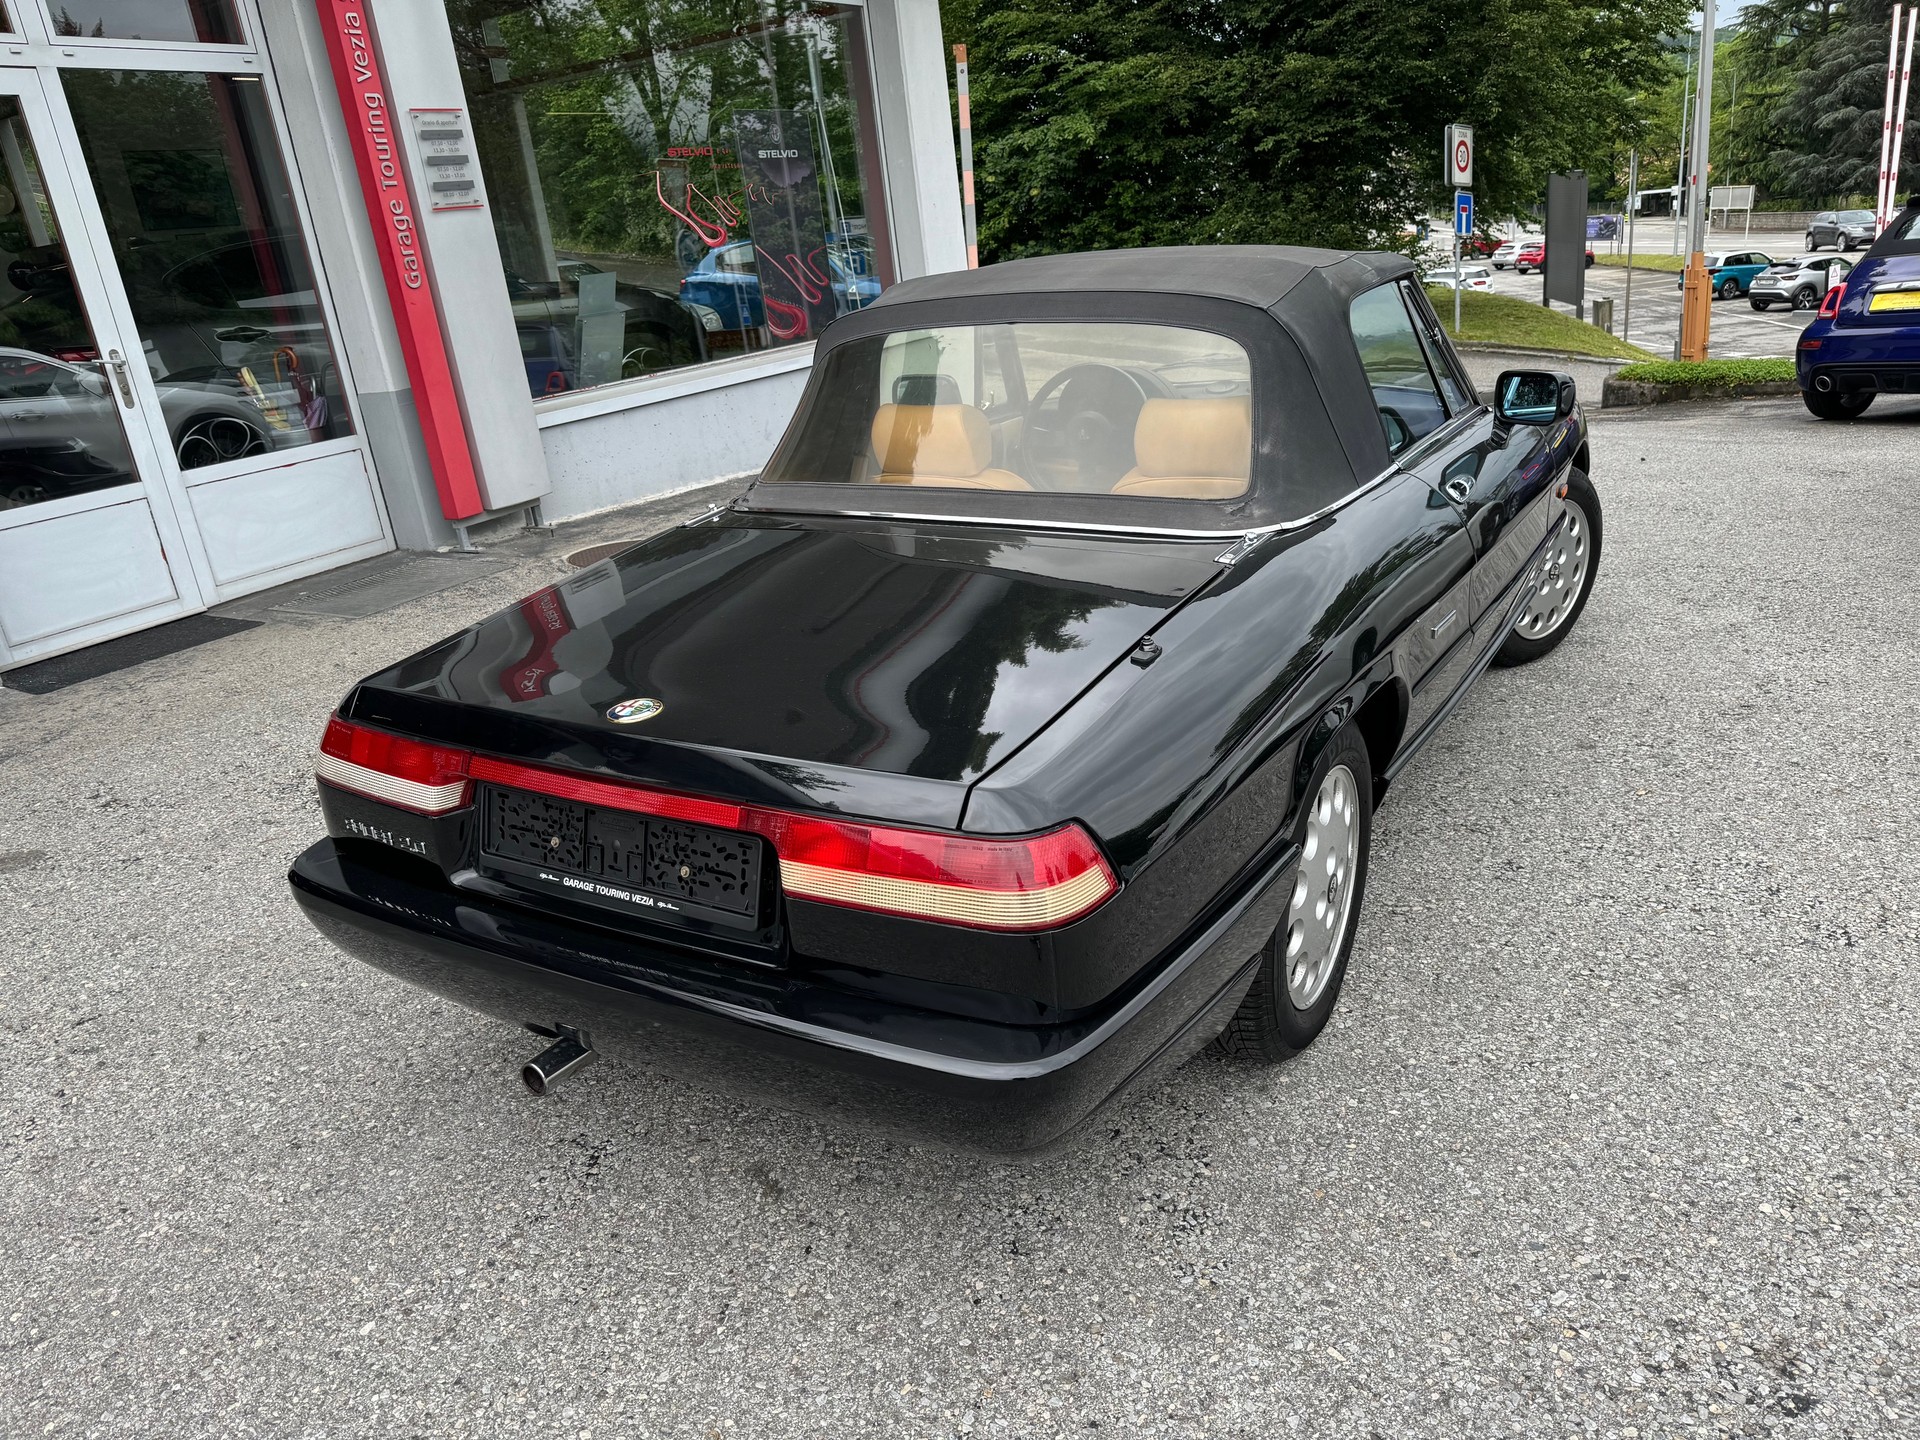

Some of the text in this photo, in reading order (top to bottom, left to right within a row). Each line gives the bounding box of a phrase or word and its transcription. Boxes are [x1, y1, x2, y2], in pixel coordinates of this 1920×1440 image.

[344, 12, 372, 83] Vezia
[364, 92, 398, 191] Touring
[667, 147, 713, 157] STELVIO
[758, 149, 798, 158] STELVIO
[390, 199, 422, 289] Garage
[563, 877, 594, 892] GARAGE
[595, 885, 630, 901] TOURING
[631, 893, 654, 907] VEZIA
